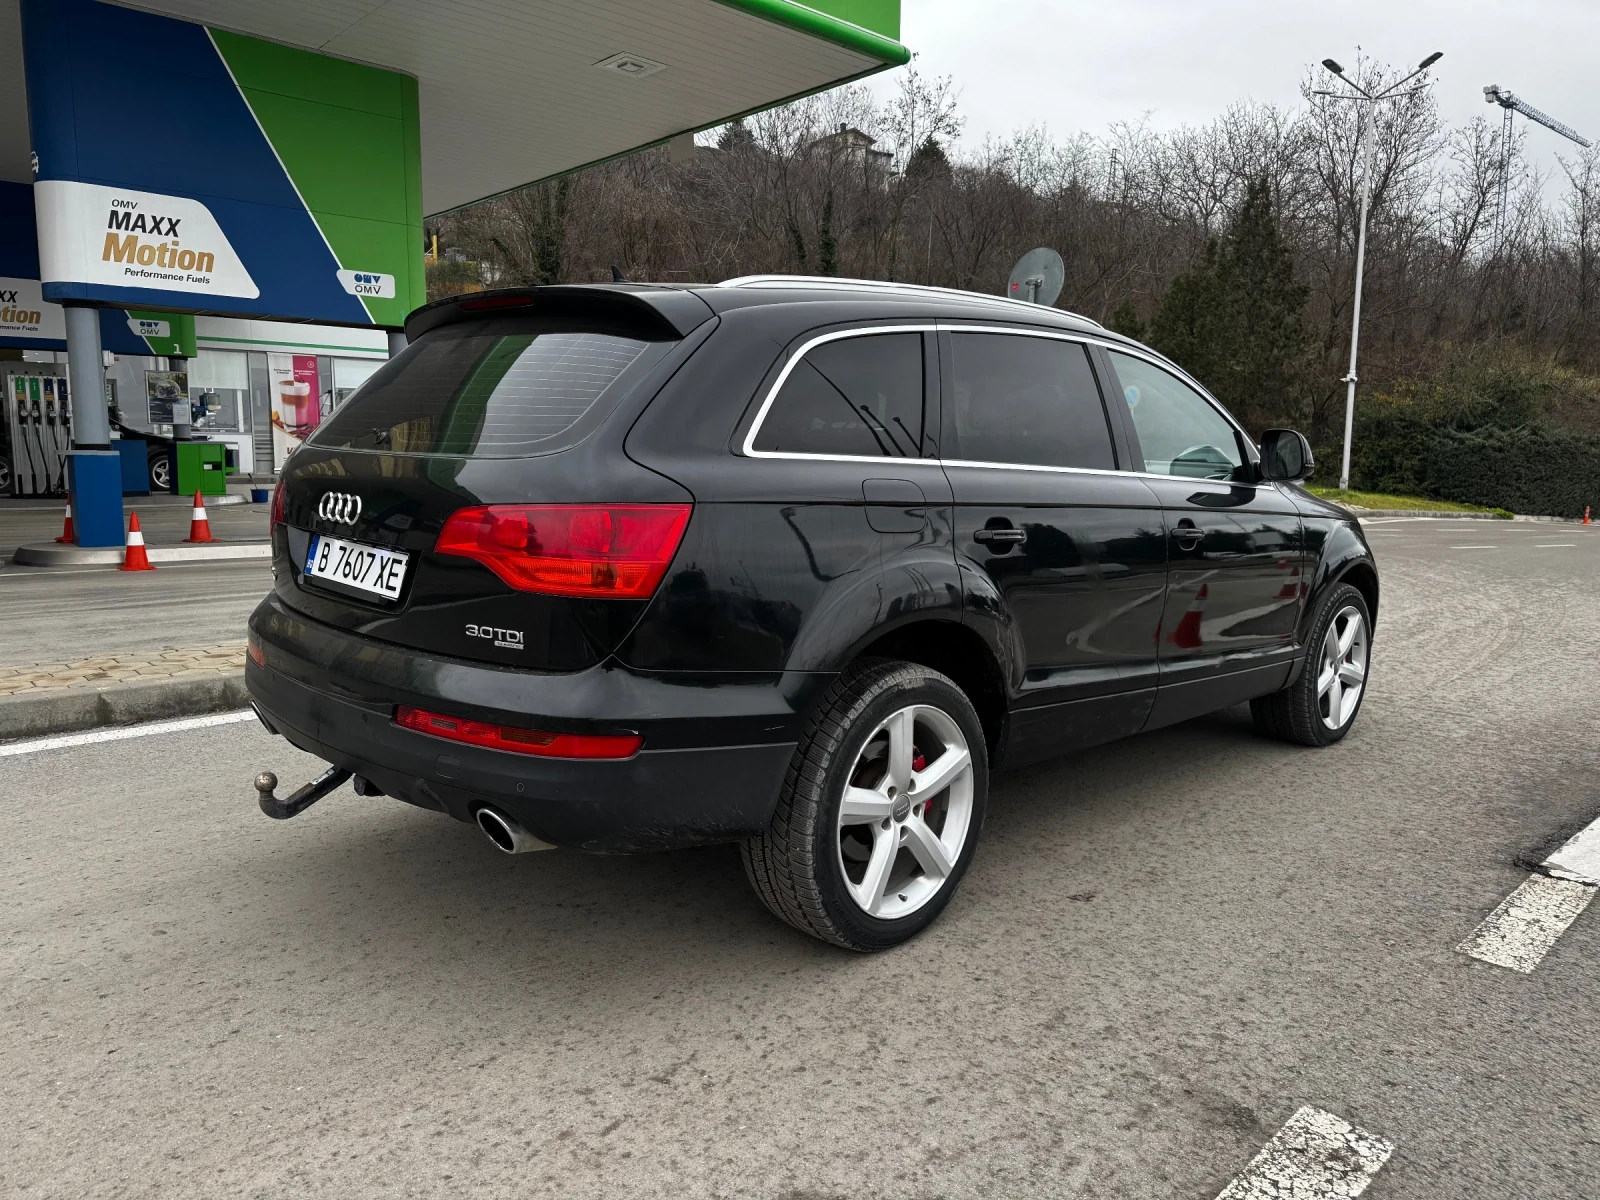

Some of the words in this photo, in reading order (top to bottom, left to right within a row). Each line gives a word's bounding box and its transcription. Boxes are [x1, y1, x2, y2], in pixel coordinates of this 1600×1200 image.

[111, 199, 138, 210] OMV
[107, 209, 181, 237] MAXX
[102, 232, 215, 273] Motion
[124, 267, 184, 281] Performance
[186, 274, 210, 284] Fuels
[354, 285, 382, 295] OMV
[0, 304, 41, 325] tion
[173, 343, 182, 355] 1
[317, 542, 331, 573] B
[333, 545, 376, 583] 7607
[373, 555, 403, 592] XE
